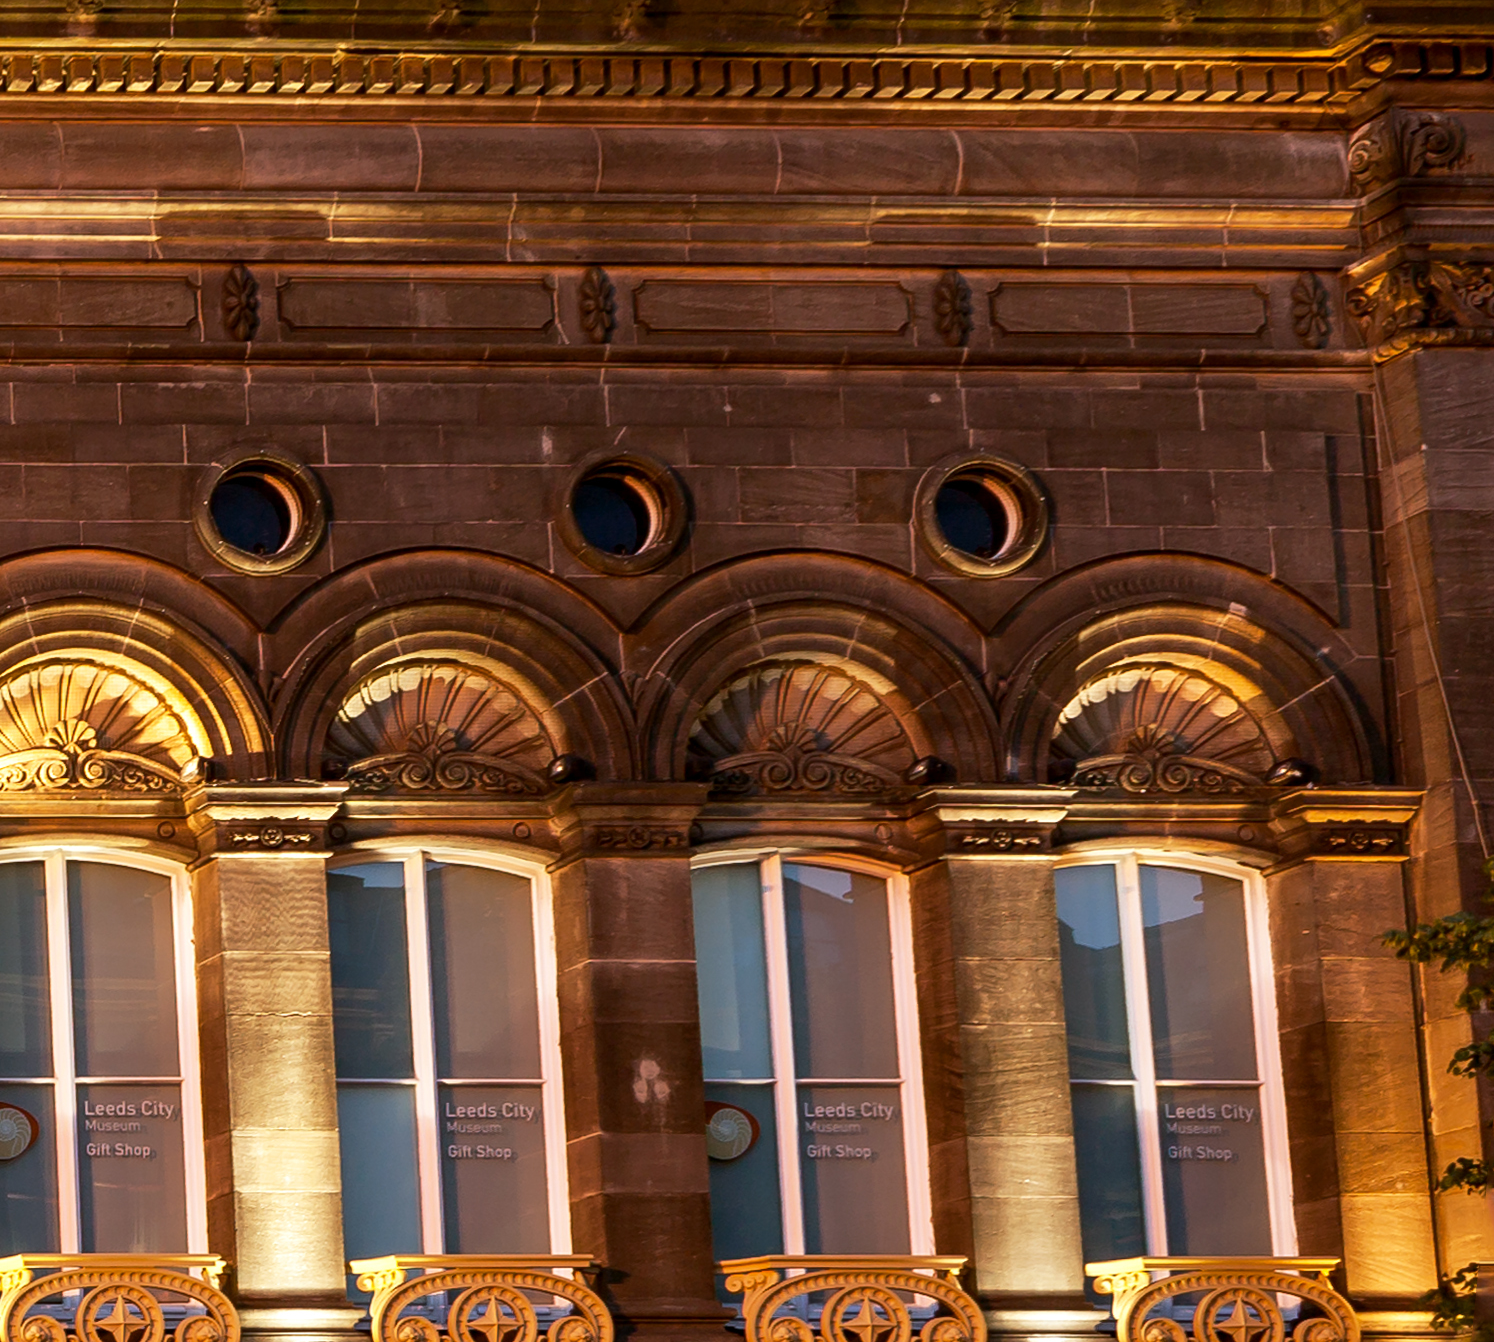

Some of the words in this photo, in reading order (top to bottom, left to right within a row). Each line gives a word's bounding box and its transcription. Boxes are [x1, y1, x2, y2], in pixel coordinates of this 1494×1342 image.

[84, 1101, 136, 1116] Leeds
[141, 1101, 174, 1119] City
[446, 1102, 497, 1117] Leeds
[502, 1102, 535, 1121] City
[804, 1102, 856, 1117] Leeds
[860, 1102, 894, 1120] City
[1164, 1104, 1216, 1119] Leeds
[1221, 1104, 1254, 1122] City
[85, 1120, 140, 1131] Museum
[447, 1121, 501, 1133] Museum
[86, 1143, 111, 1156] Gift
[114, 1143, 151, 1159] Shop
[448, 1145, 472, 1158] Gift
[476, 1145, 512, 1160] Shop
[807, 1144, 831, 1157] Gift
[835, 1144, 872, 1160] Shop
[1168, 1146, 1192, 1158] Gift
[1196, 1146, 1232, 1161] Shop
